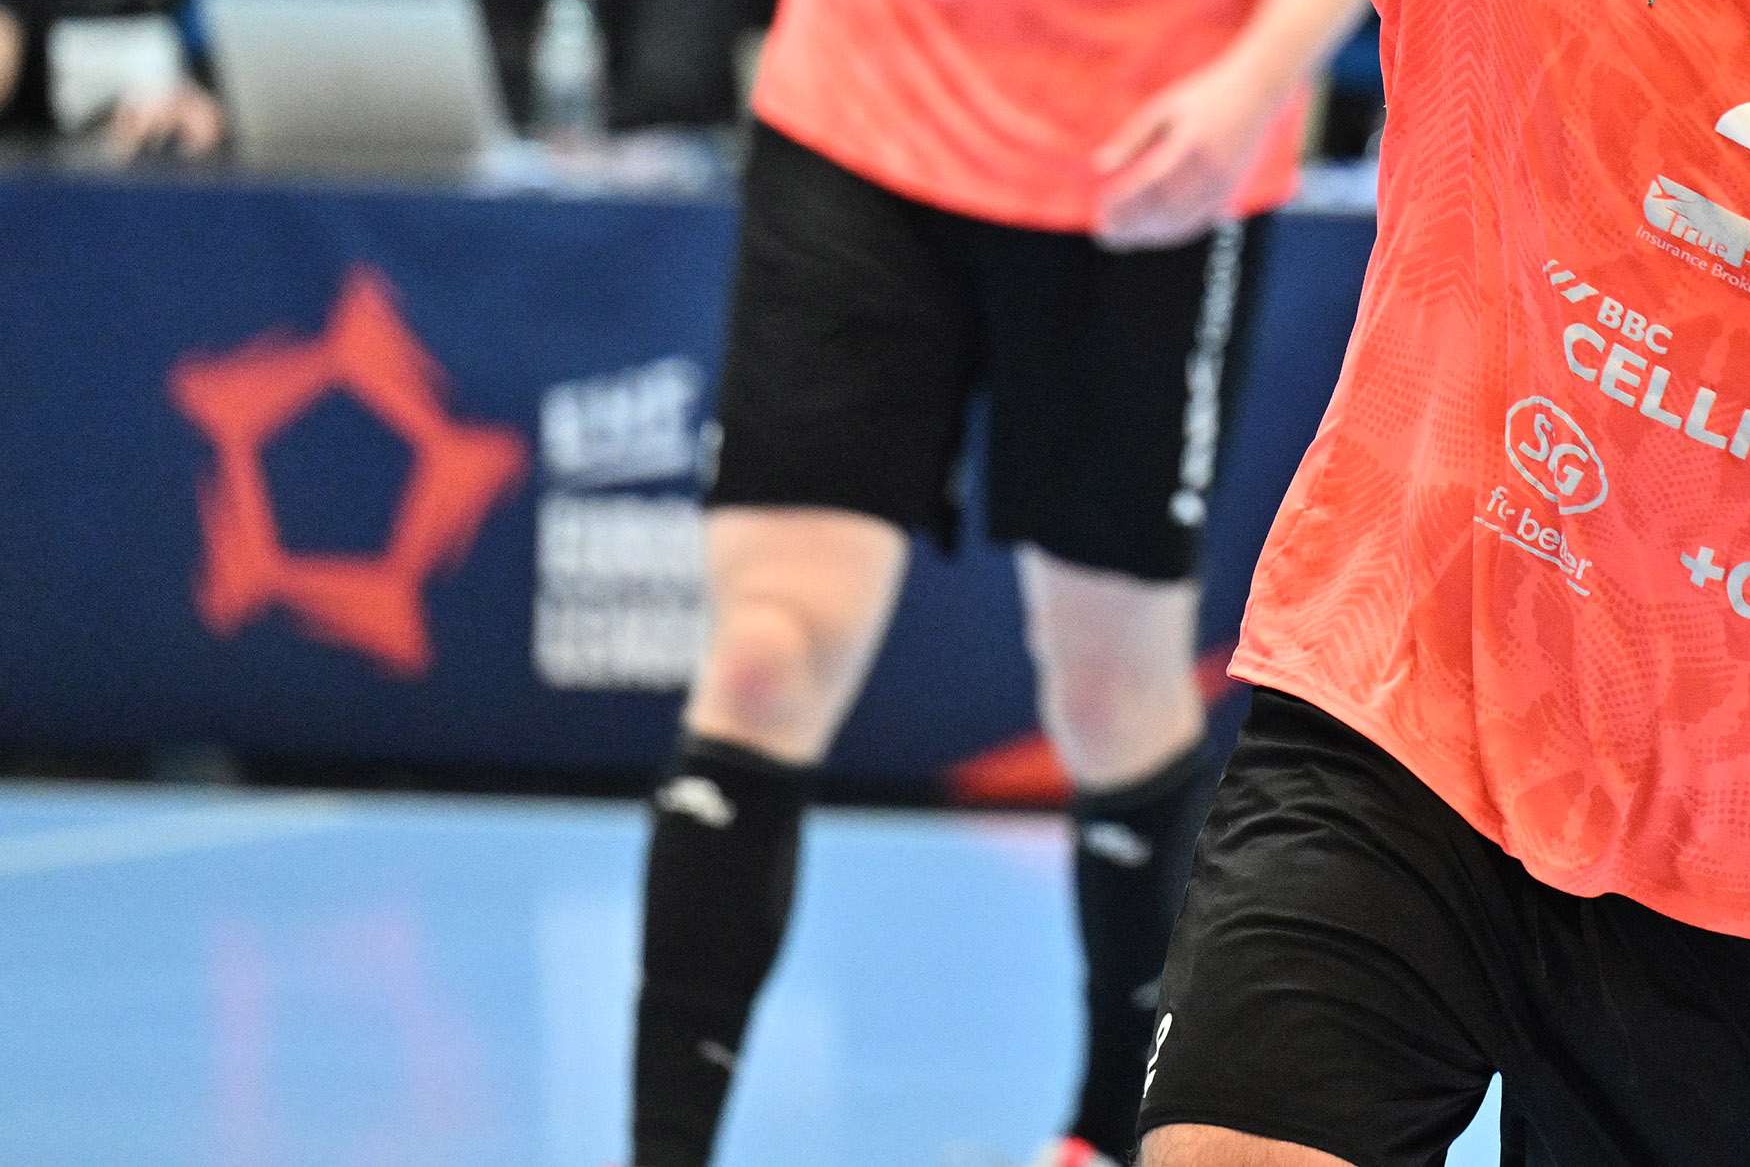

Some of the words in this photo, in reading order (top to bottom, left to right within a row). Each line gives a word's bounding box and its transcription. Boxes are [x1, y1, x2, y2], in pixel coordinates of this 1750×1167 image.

[1635, 224, 1708, 271] Insurance
[1597, 296, 1673, 354] BBC
[1518, 413, 1588, 496] SG
